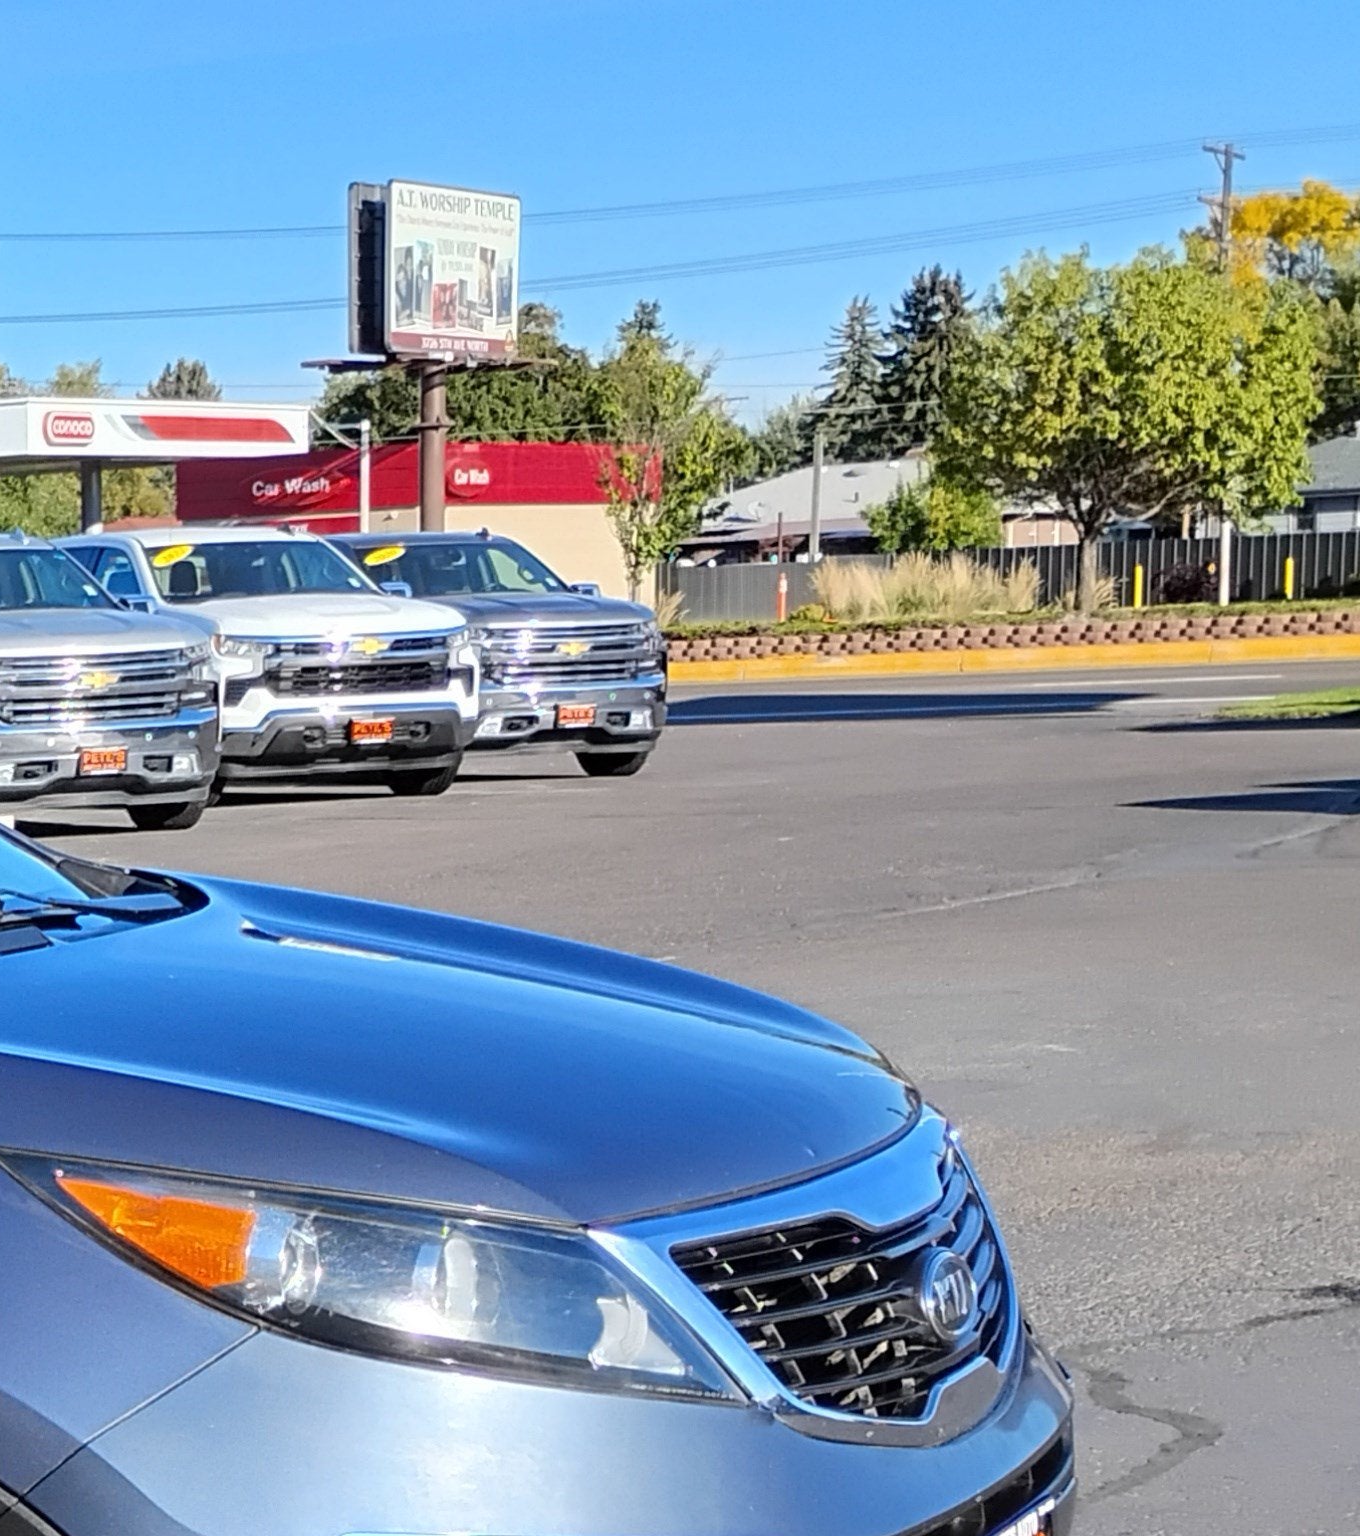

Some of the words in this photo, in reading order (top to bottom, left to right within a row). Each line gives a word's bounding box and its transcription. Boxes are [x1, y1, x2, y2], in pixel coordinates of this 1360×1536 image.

[419, 191, 471, 215] WORSHIP
[474, 198, 515, 222] TEMPLE
[453, 468, 469, 485] Car
[469, 468, 491, 485] Wash
[251, 480, 279, 497] Car
[283, 477, 331, 495] Wash
